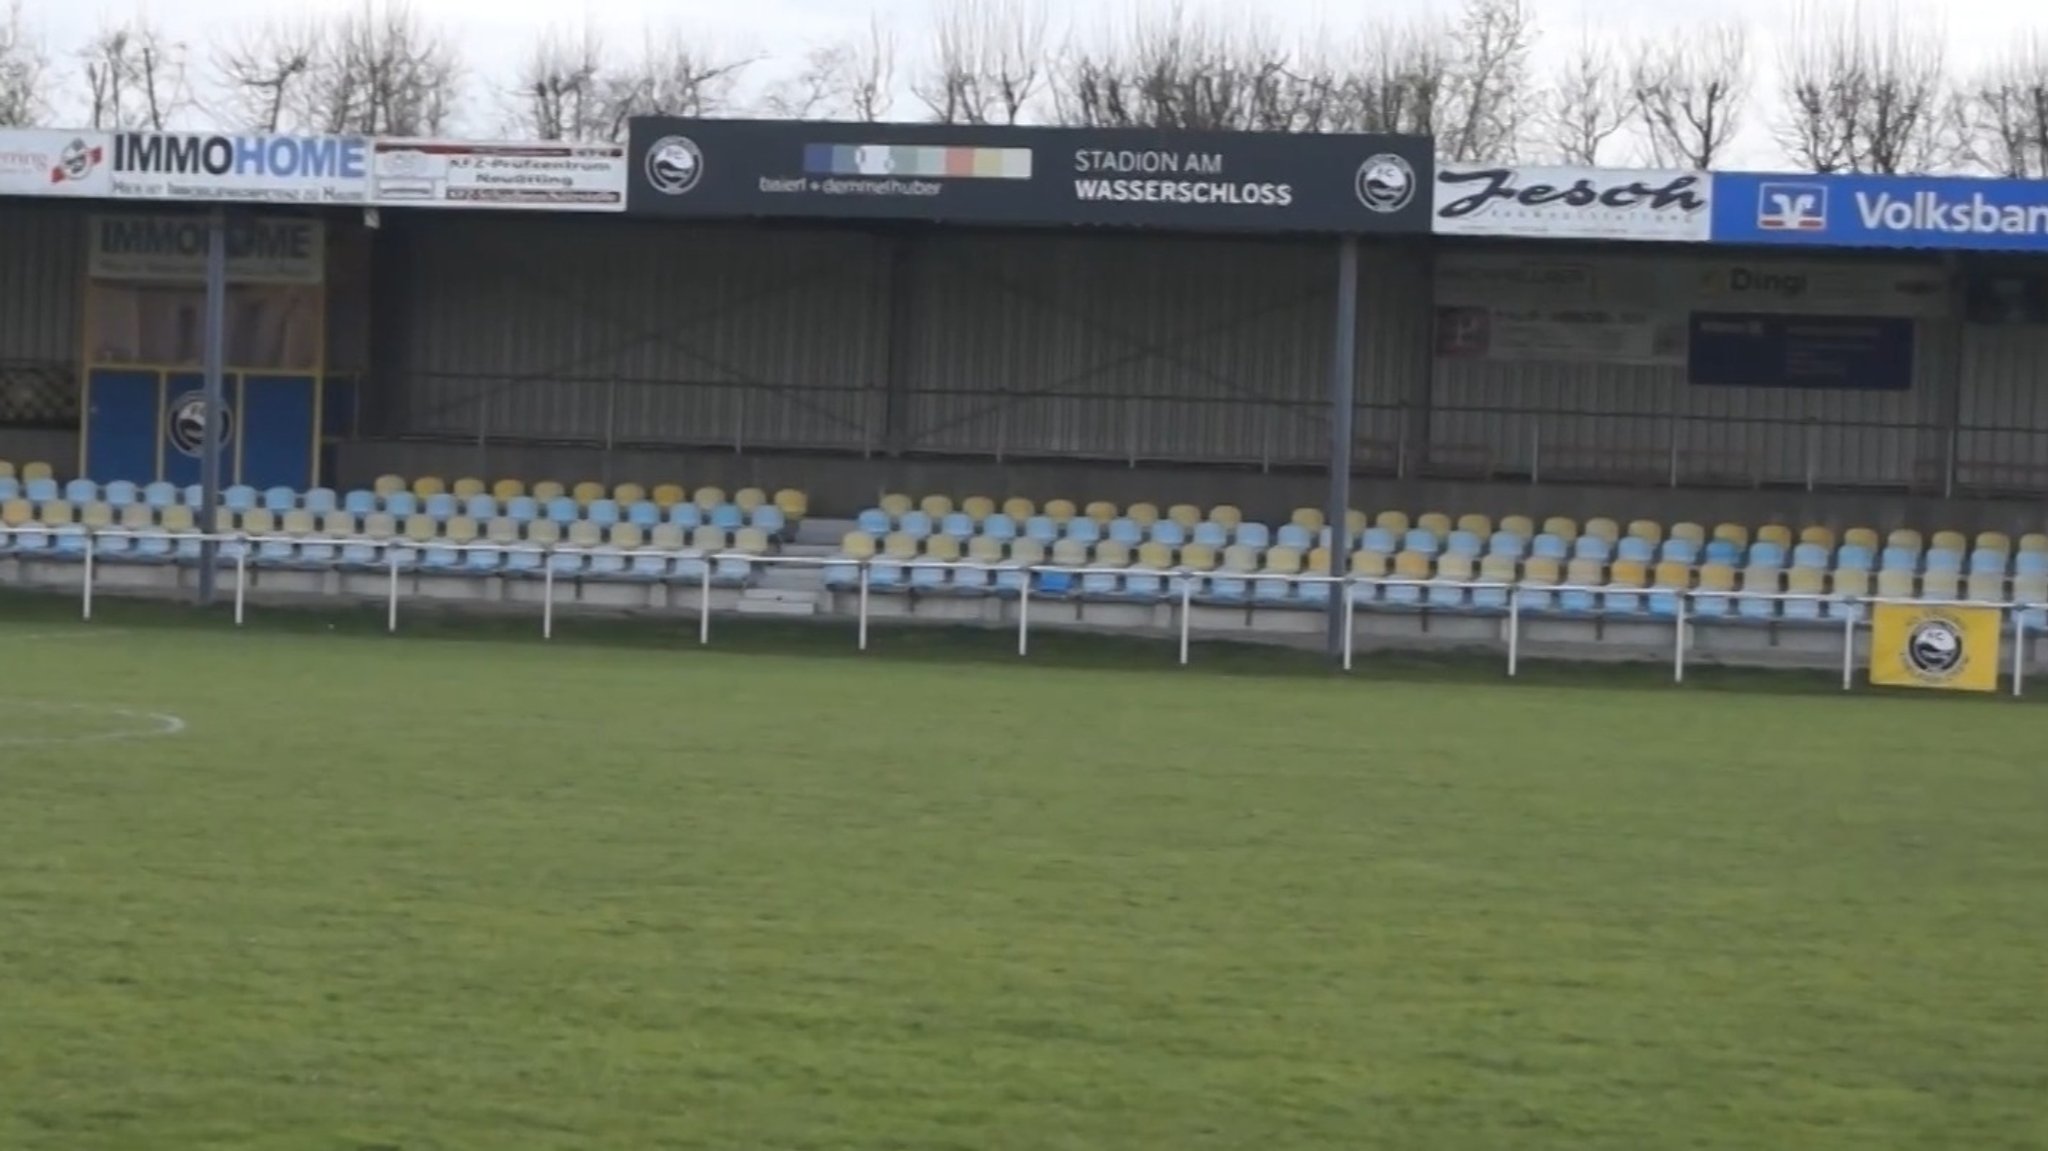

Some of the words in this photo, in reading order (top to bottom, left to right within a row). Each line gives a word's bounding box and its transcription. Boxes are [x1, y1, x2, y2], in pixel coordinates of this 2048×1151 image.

[115, 133, 365, 179] IMMOHOME
[1075, 149, 1179, 173] STADION
[1184, 152, 1223, 174] AM
[1074, 178, 1293, 206] WASSERSCHLOSS
